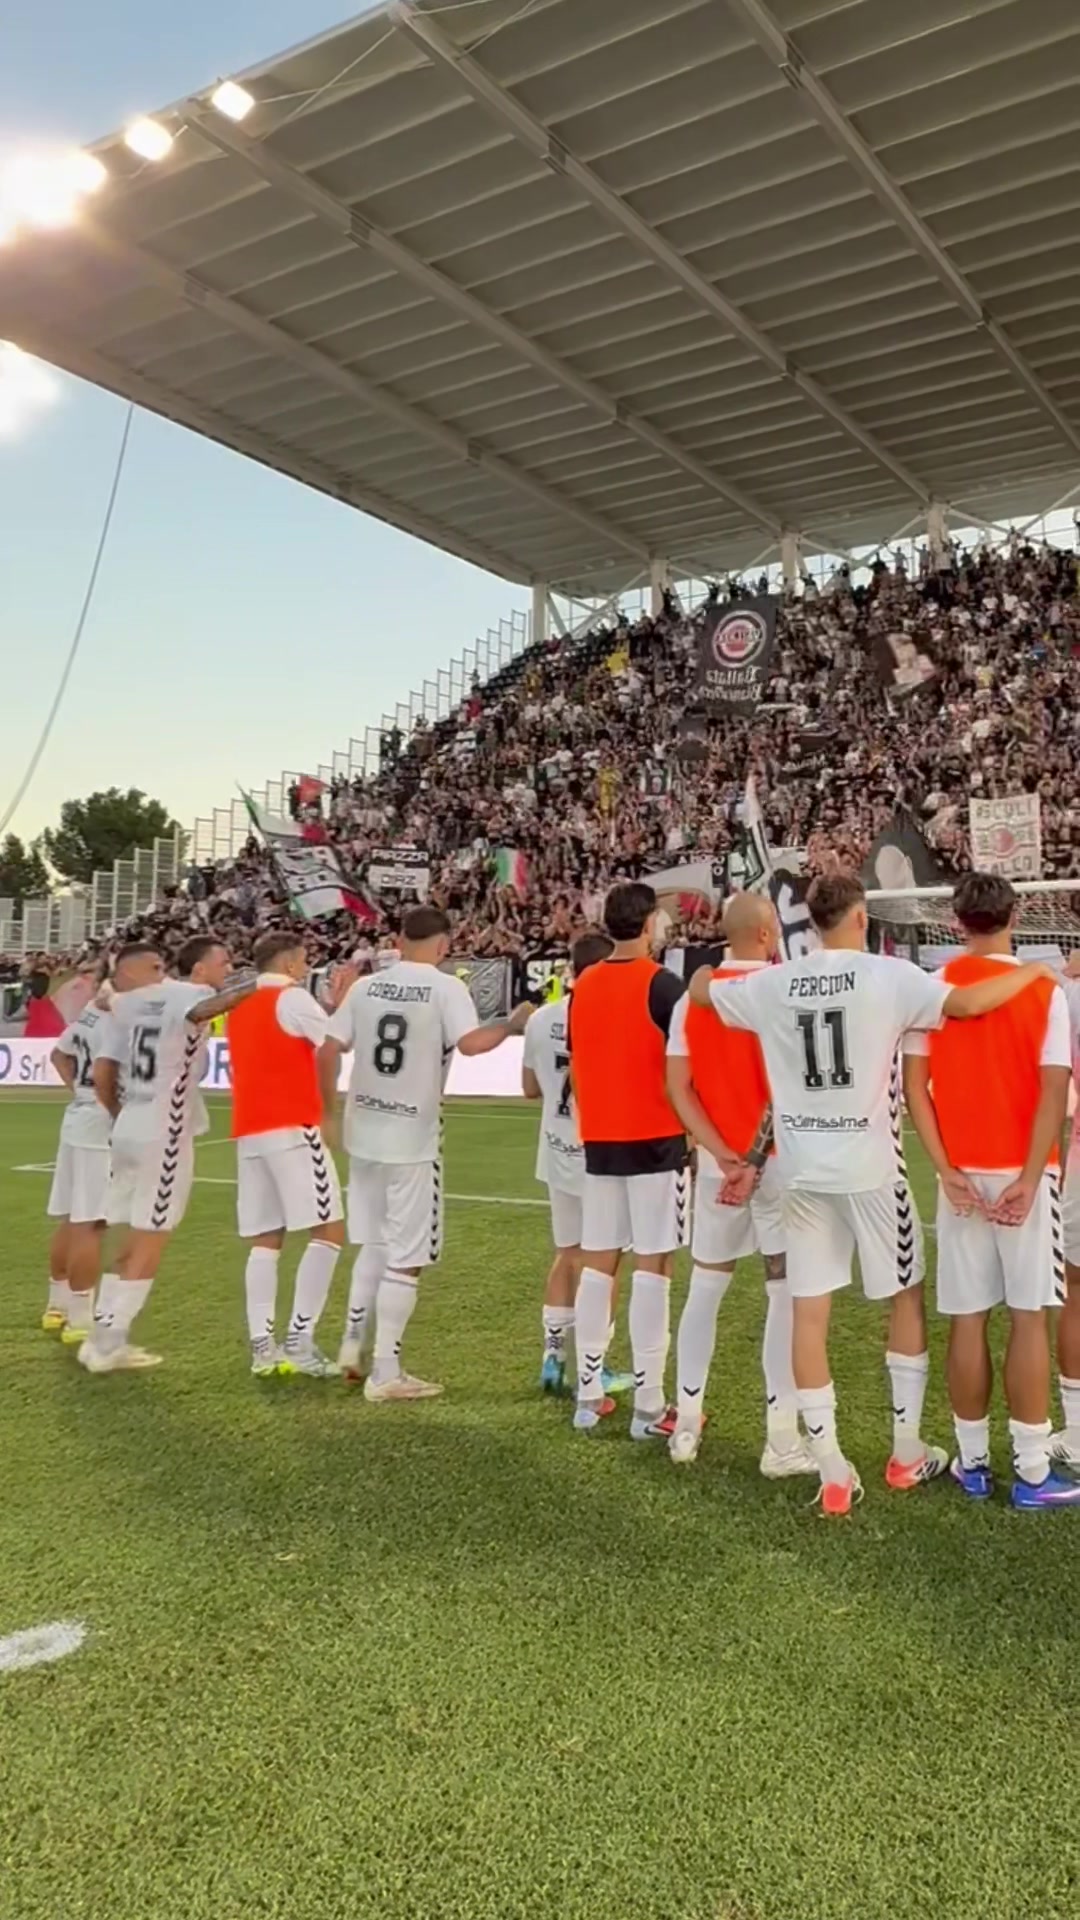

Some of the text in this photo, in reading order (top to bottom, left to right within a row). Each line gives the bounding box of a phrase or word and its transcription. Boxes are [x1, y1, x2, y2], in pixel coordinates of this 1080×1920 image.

[788, 972, 856, 997] PERCIUN
[19, 1054, 47, 1081] Srl
[128, 1023, 162, 1083] 15
[373, 1010, 409, 1078] 8
[794, 1006, 855, 1092] 11
